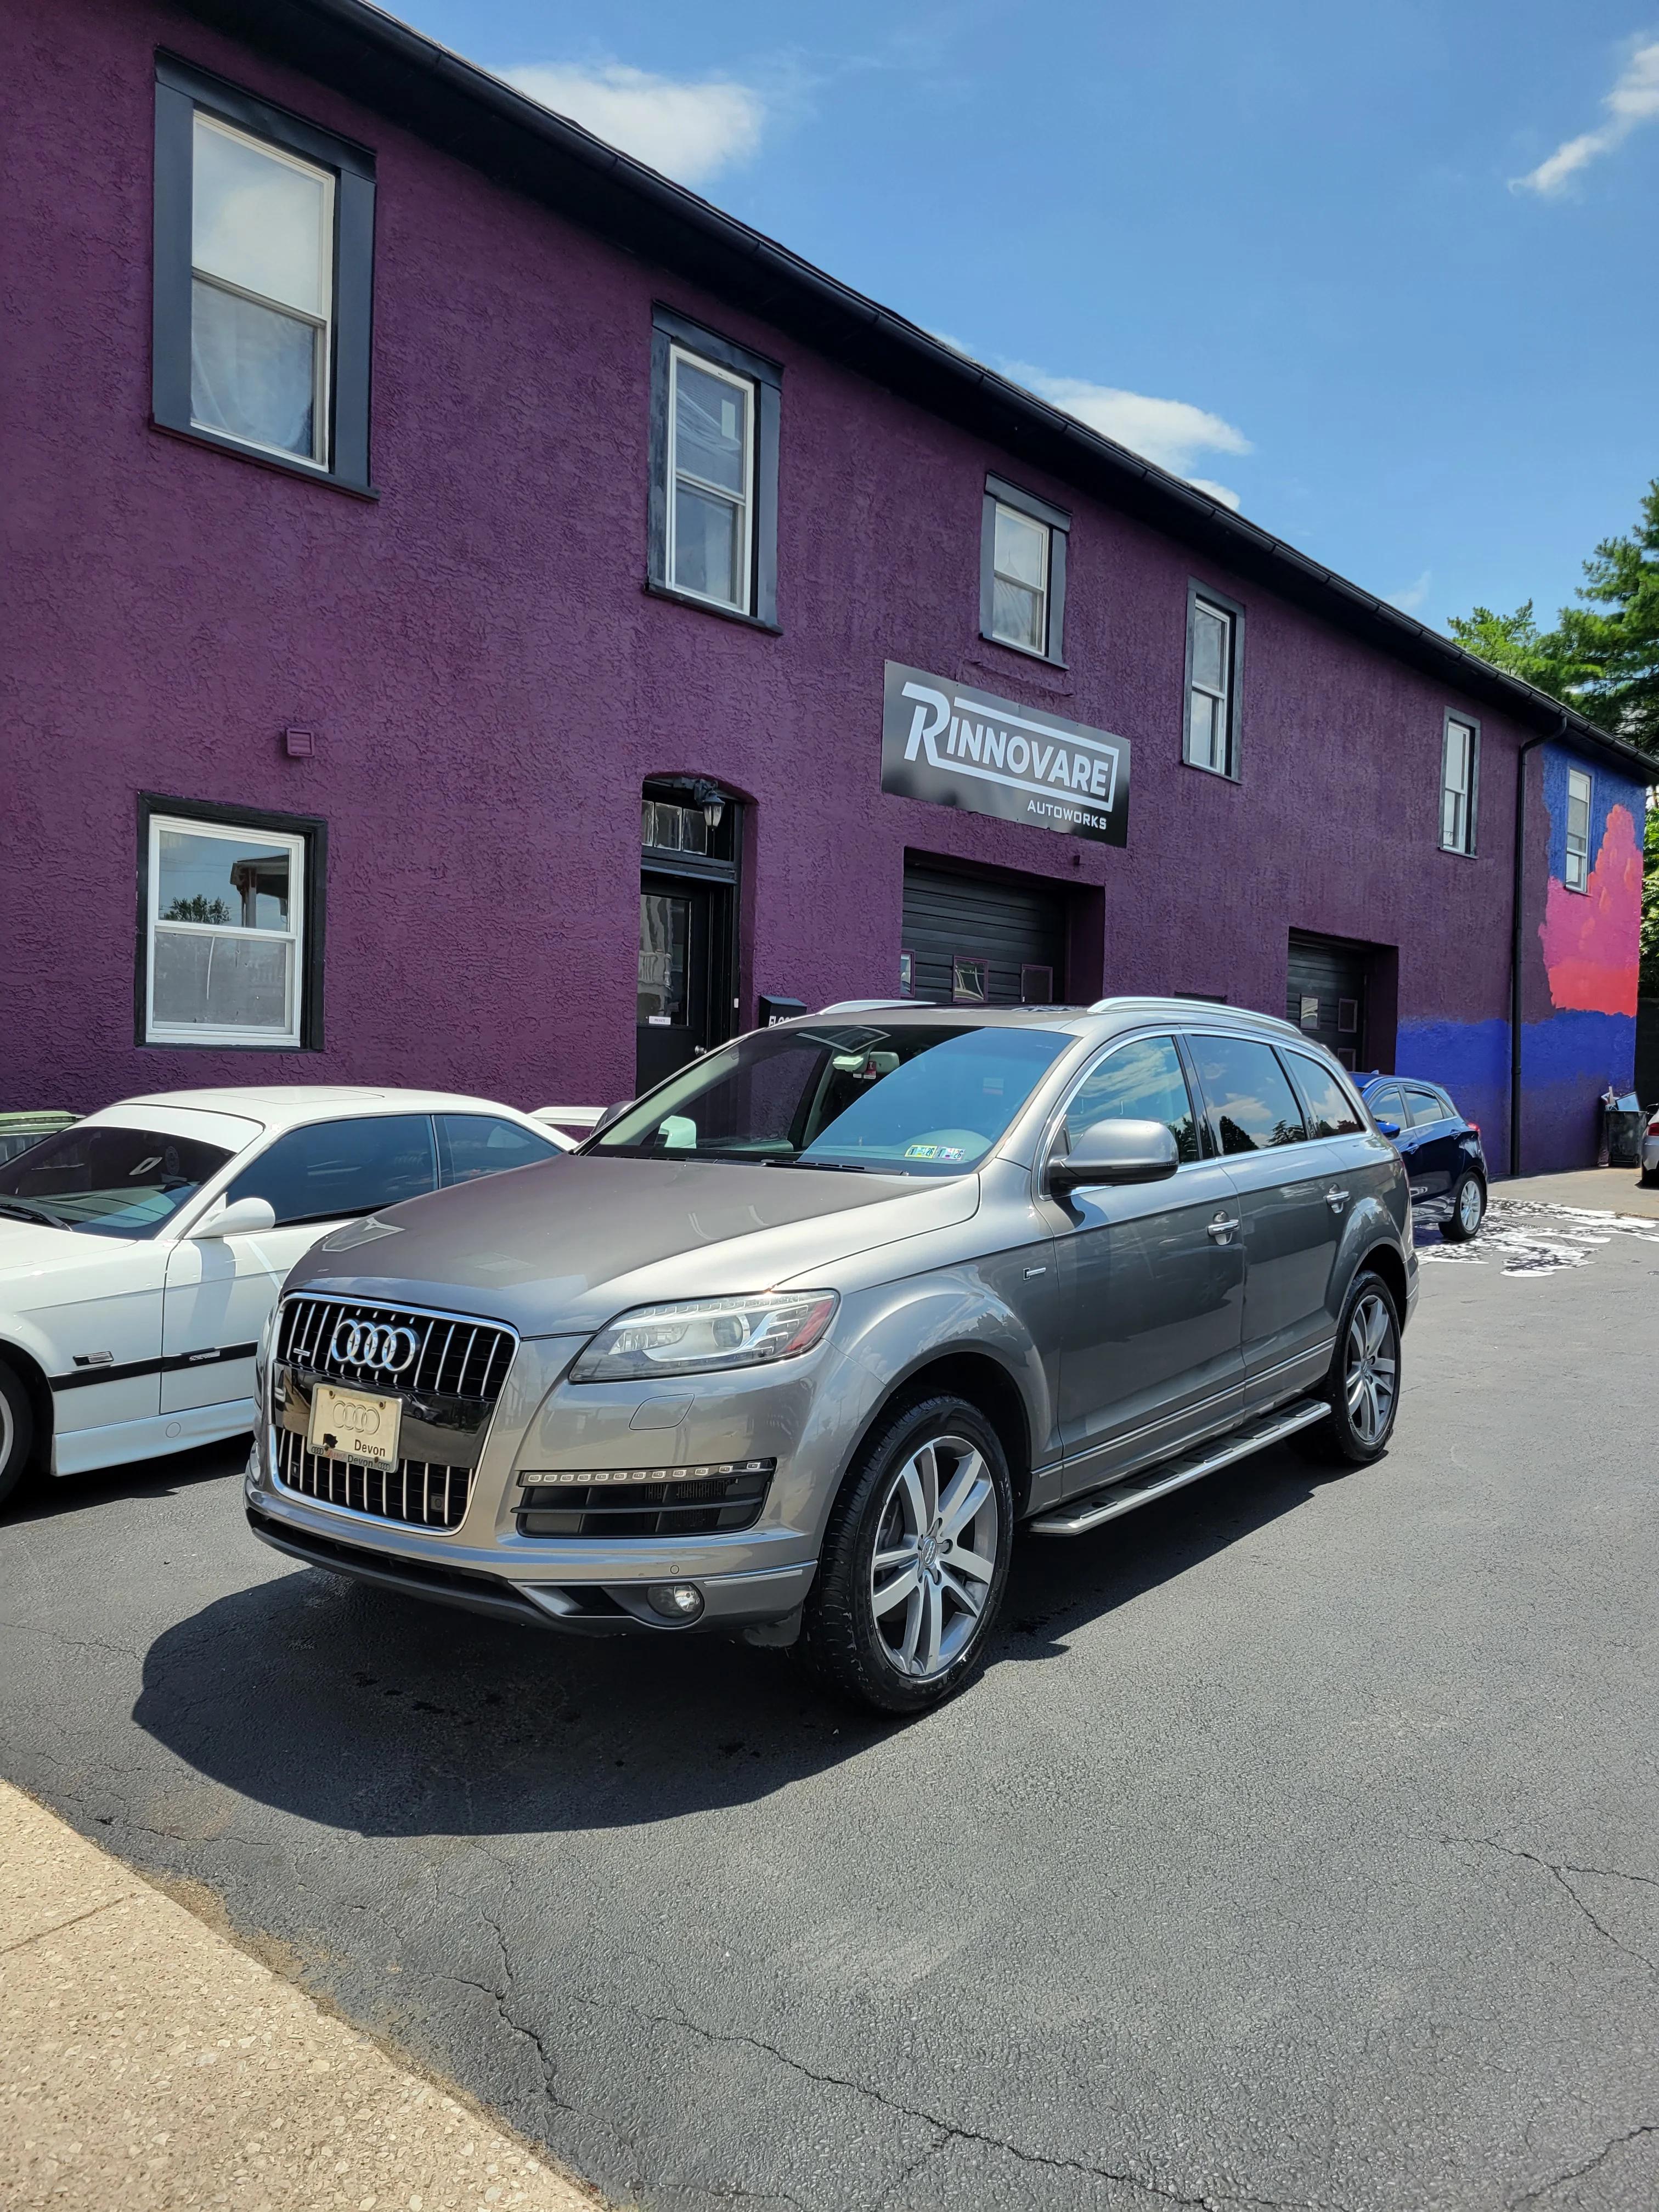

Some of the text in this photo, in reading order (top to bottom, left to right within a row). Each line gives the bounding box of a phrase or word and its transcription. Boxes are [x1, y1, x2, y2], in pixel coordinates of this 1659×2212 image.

[902, 681, 1109, 797] RINNOVARE
[1027, 799, 1107, 830] AUTOWORKS
[354, 1439, 386, 1457] Devon
[347, 1454, 374, 1468] Devon
